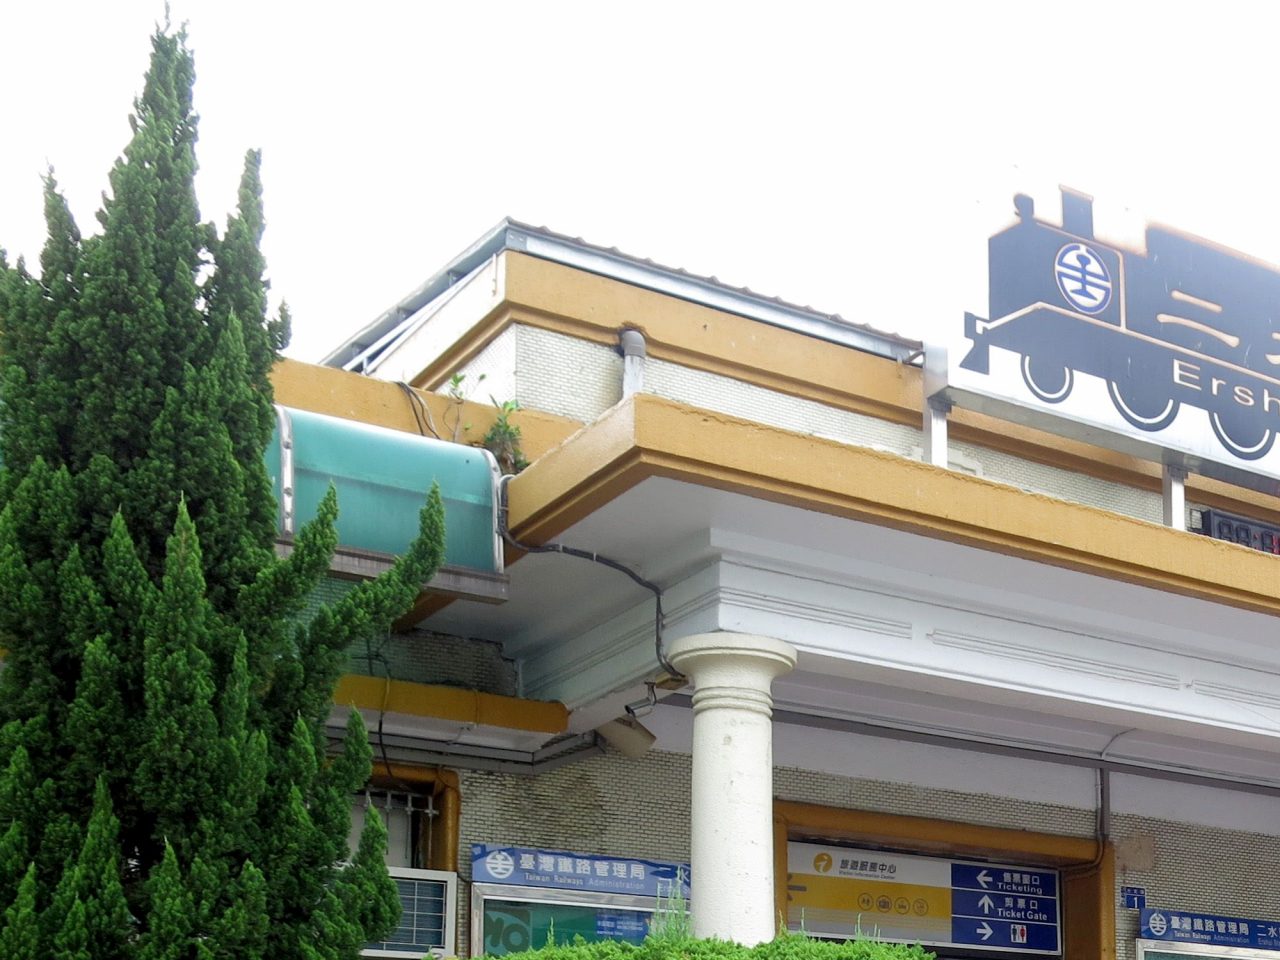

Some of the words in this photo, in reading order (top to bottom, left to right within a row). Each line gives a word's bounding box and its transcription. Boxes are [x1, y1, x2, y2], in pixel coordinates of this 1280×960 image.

[519, 853, 646, 880] 臺灣鐵路管理局
[524, 872, 550, 882] Taiwan
[554, 875, 584, 886] Railways
[588, 877, 645, 890] Administration
[997, 882, 1043, 894] Ticketing
[997, 908, 1025, 919] Ticket
[1026, 911, 1048, 921] Gate
[1170, 915, 1249, 936] 臺灣鐵路管理局
